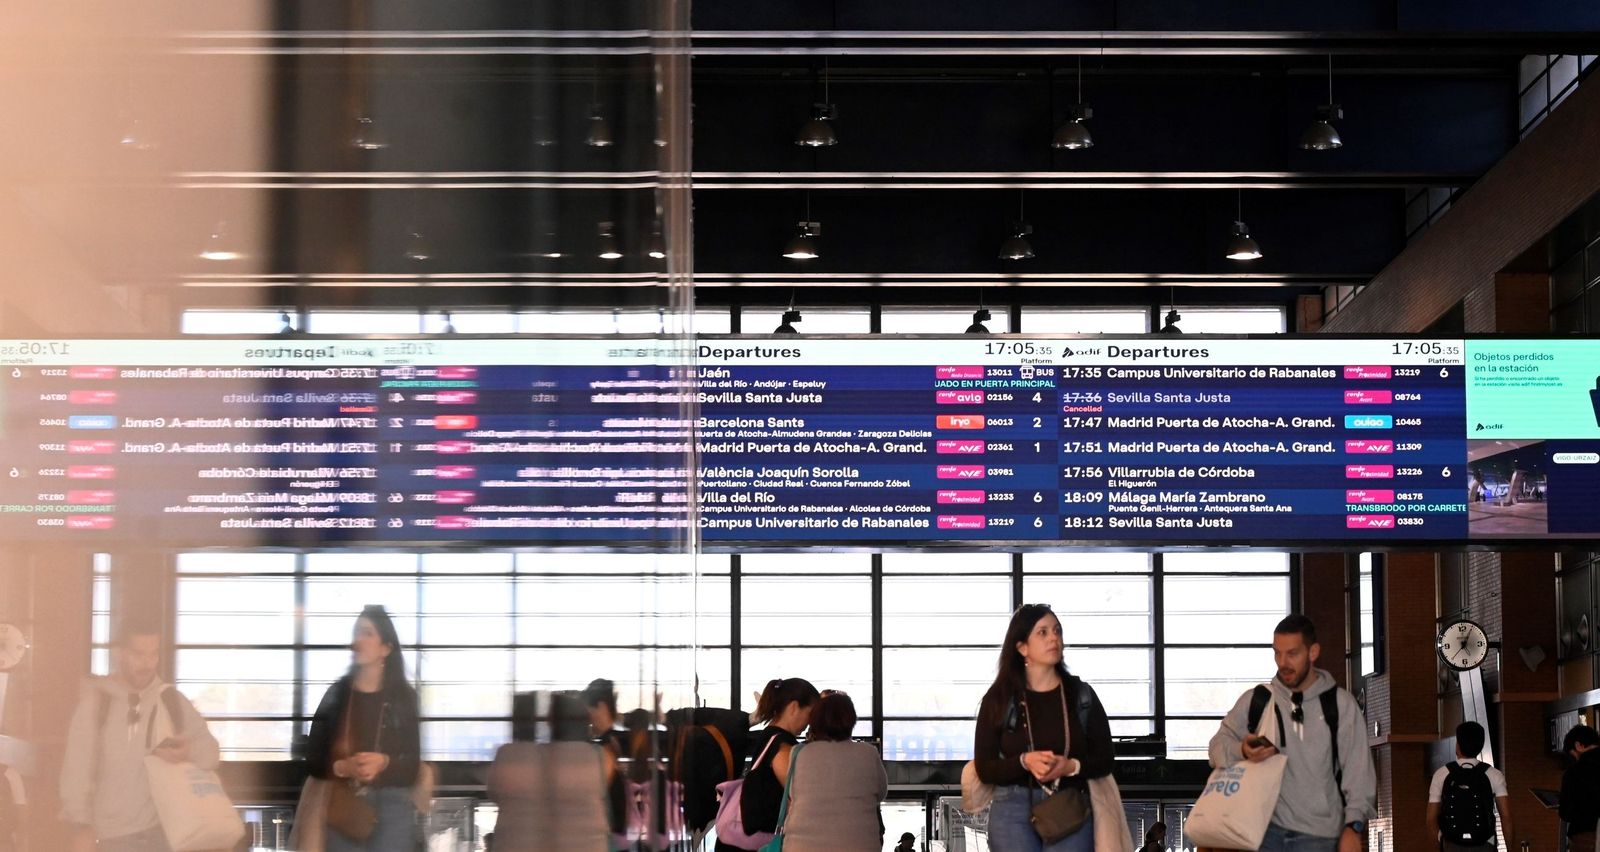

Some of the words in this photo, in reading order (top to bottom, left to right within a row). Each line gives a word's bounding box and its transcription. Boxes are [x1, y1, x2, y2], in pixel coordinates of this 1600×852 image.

[699, 346, 801, 360] Departures
[985, 342, 1052, 354] 17:05:35
[1108, 346, 1209, 360] Departures
[1393, 342, 1458, 354] 17:05:35
[1474, 353, 1511, 362] Objetos
[1513, 353, 1554, 363] perdidos
[698, 367, 730, 378] Jaén
[1063, 368, 1101, 378] 17:35
[1107, 368, 1160, 380] Campus
[1164, 367, 1246, 378] Universitario
[1249, 367, 1266, 378] de
[1270, 367, 1336, 378] Rabanales
[1440, 367, 1448, 378] 6
[754, 380, 786, 389] Andújar
[793, 380, 826, 389] Espeluy
[698, 392, 742, 403] Sevilla
[745, 392, 782, 403] Santa
[786, 392, 822, 403] Justa
[958, 394, 981, 403] avlo
[1032, 392, 1042, 403] 4
[1063, 392, 1102, 402] 17:36
[1108, 392, 1150, 402] Sevilla
[1154, 392, 1191, 402] Santa
[1195, 393, 1230, 402] Justa
[700, 417, 764, 428] Barcelona
[768, 417, 804, 427] Sants
[950, 417, 970, 427] iryo
[1033, 417, 1041, 428] 2
[1064, 417, 1102, 428] 17:47
[1108, 417, 1153, 427] Madrid
[1157, 417, 1199, 428] Puerta
[1202, 417, 1219, 427] de
[1222, 417, 1288, 427] Atocha-A.
[1292, 417, 1335, 427] Grand.
[858, 430, 897, 439] Zaragoza
[700, 442, 744, 453] Madrid
[748, 442, 790, 452] Puerta
[794, 442, 810, 452] de
[813, 442, 880, 452] Atocha-A.
[883, 442, 927, 452] Grand.
[1034, 442, 1040, 452] 1
[1064, 442, 1102, 452] 17:51
[1108, 442, 1153, 452] Madrid
[1157, 442, 1200, 452] Puerta
[1203, 442, 1220, 452] de
[1223, 442, 1289, 452] Atocha-A.
[1292, 442, 1335, 452] Grand.
[700, 467, 754, 477] València
[757, 467, 809, 479] Joaquín
[812, 467, 859, 477] Sorolla
[1064, 467, 1102, 478] 17:56
[1108, 467, 1175, 477] Villarrubia
[1178, 467, 1195, 477] de
[1198, 467, 1254, 477] Córdoba
[1442, 467, 1451, 477] 6
[1118, 480, 1156, 488] Higuerón
[700, 492, 727, 503] Villa
[730, 492, 751, 502] del
[755, 492, 775, 502] Río
[1034, 492, 1042, 502] 6
[1065, 492, 1103, 502] 18:09
[1109, 492, 1156, 504] Málaga
[1159, 492, 1196, 503] María
[1199, 492, 1265, 503] Zambrano
[699, 505, 732, 514] Campus
[1204, 505, 1248, 513] Antequera
[701, 517, 752, 530] Campus
[756, 517, 838, 528] Universitario
[842, 517, 858, 528] de
[862, 517, 929, 528] Rabanales
[1034, 517, 1042, 528] 6
[1065, 517, 1103, 528] 18:12
[1109, 517, 1152, 527] Sevilla
[1156, 517, 1193, 527] Santa
[1196, 517, 1232, 527] Justa
